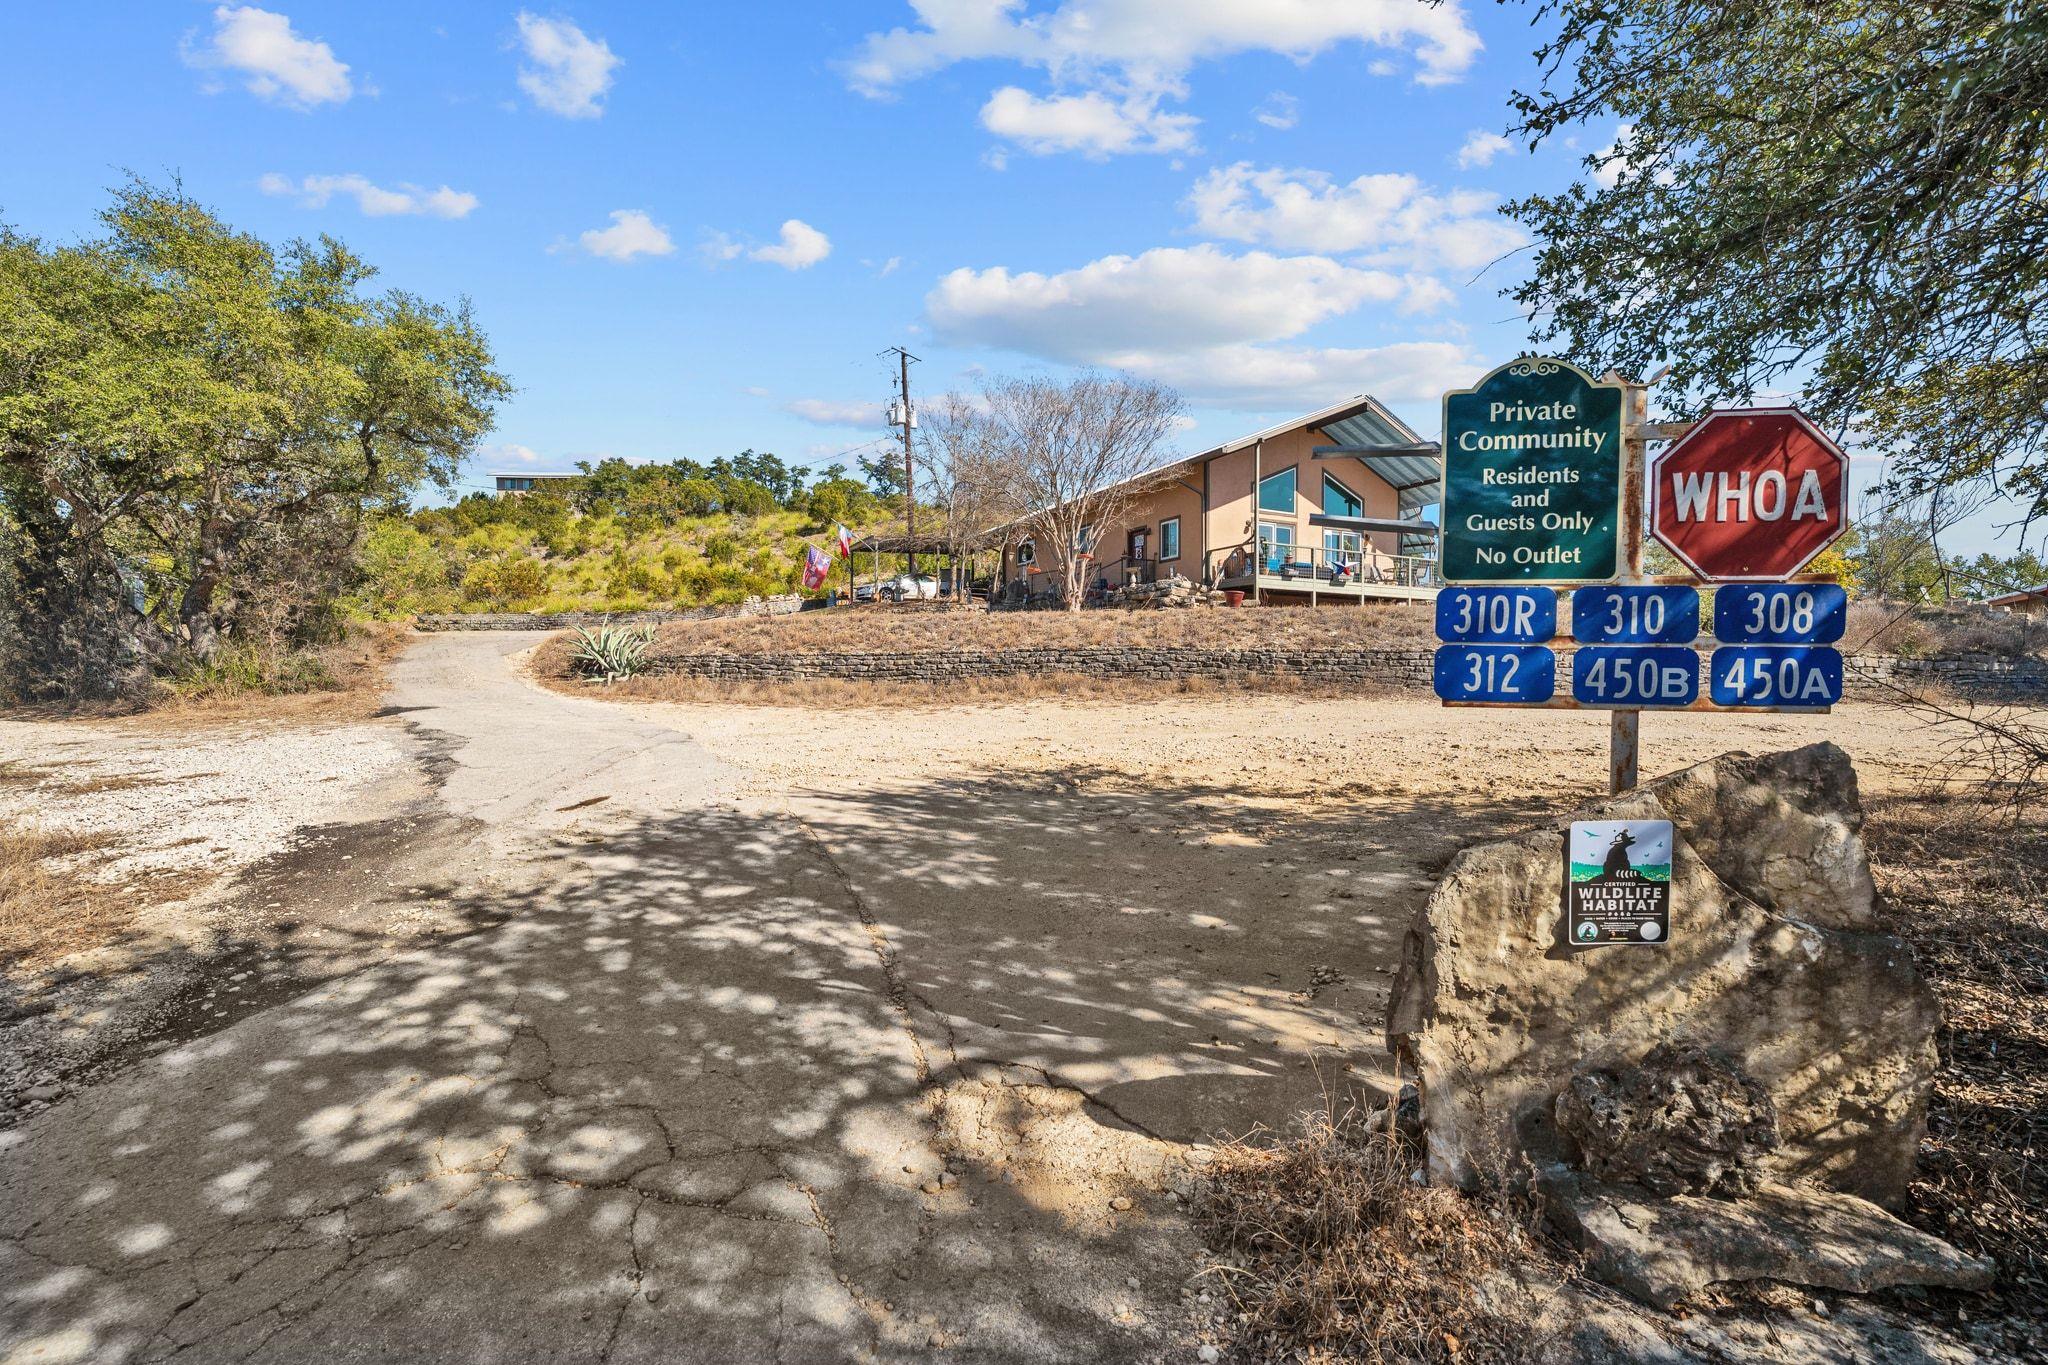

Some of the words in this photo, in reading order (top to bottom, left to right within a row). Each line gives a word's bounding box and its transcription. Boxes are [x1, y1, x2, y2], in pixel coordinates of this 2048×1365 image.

[1489, 399, 1577, 423] Private
[1459, 425, 1607, 454] Community
[1482, 465, 1580, 485] Residents
[1511, 488, 1550, 508] and
[1672, 469, 1829, 522] WHOA
[1466, 514, 1536, 532] Guests
[1541, 511, 1594, 535] Only
[1475, 547, 1507, 565] No
[1513, 545, 1582, 565] Outlet
[1453, 594, 1537, 636] 310R
[1603, 593, 1665, 635] 310
[1744, 591, 1814, 635] 308
[1463, 652, 1520, 693] 312
[1584, 657, 1689, 699] 450B
[1724, 657, 1832, 700] 450A
[1578, 887, 1662, 899] WILDLIFE
[1582, 899, 1658, 911] HABITAT
